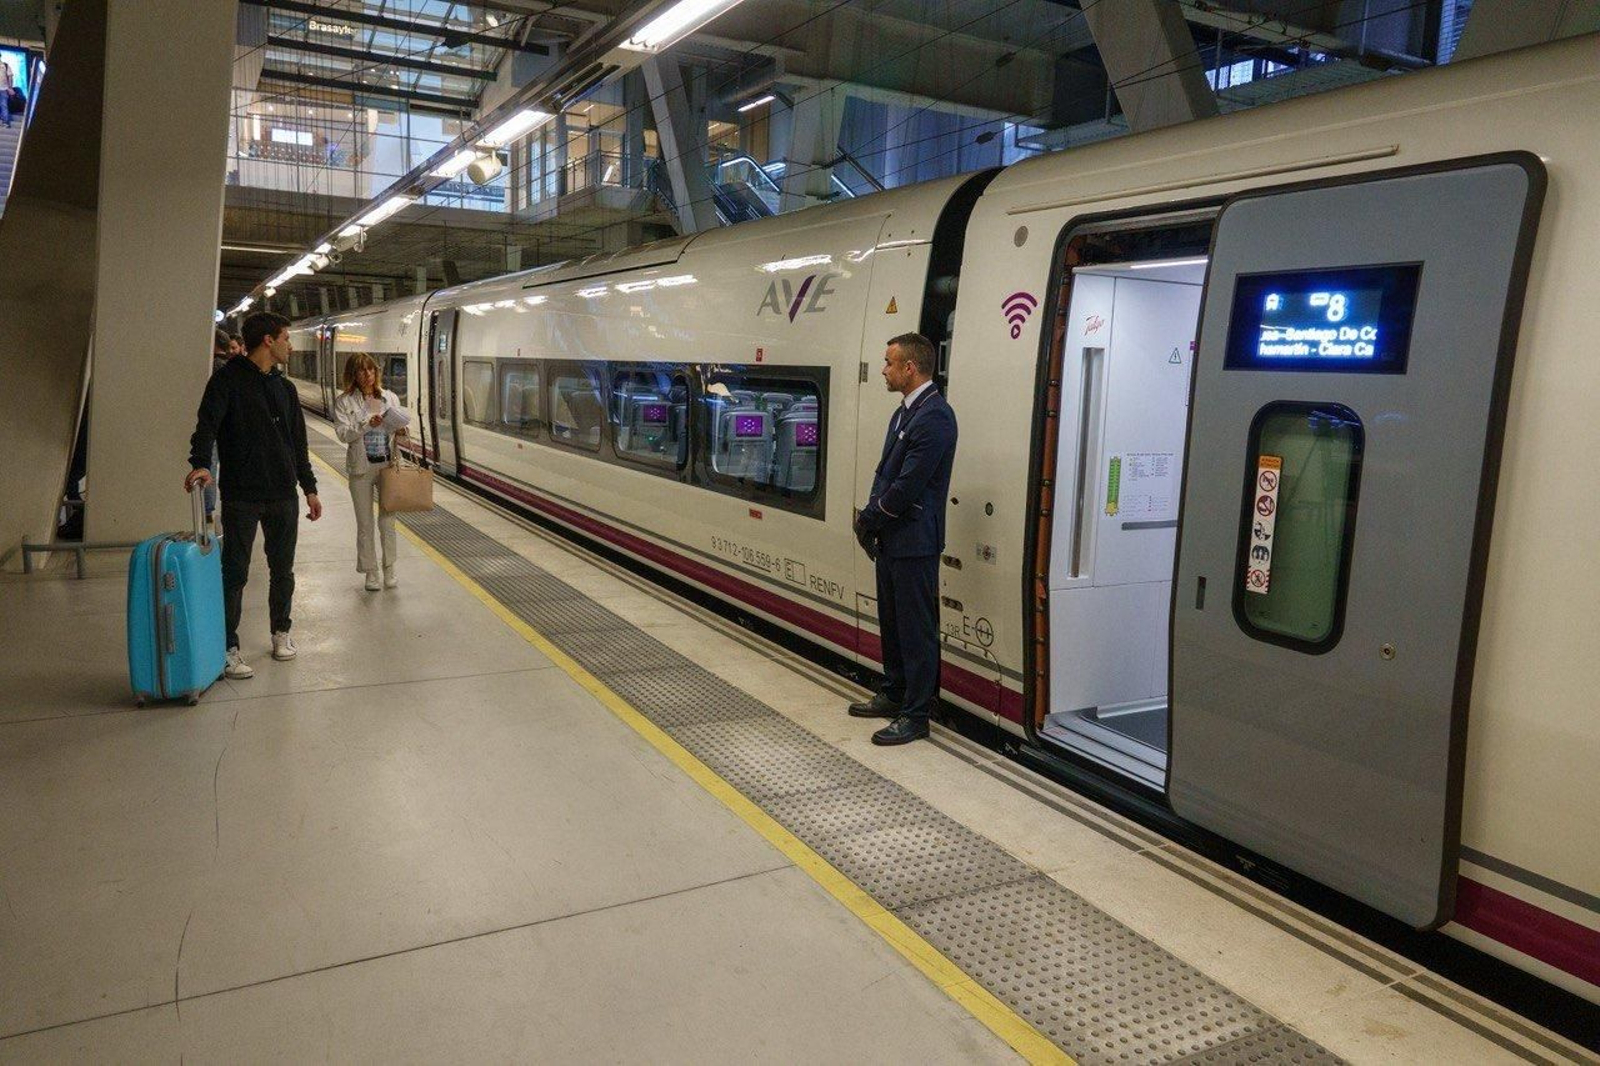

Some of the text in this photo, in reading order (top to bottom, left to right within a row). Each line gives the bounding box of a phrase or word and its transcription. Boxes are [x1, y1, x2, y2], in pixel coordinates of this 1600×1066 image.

[755, 272, 841, 323] AVE
[1327, 293, 1346, 322] 8
[1339, 327, 1359, 341] De
